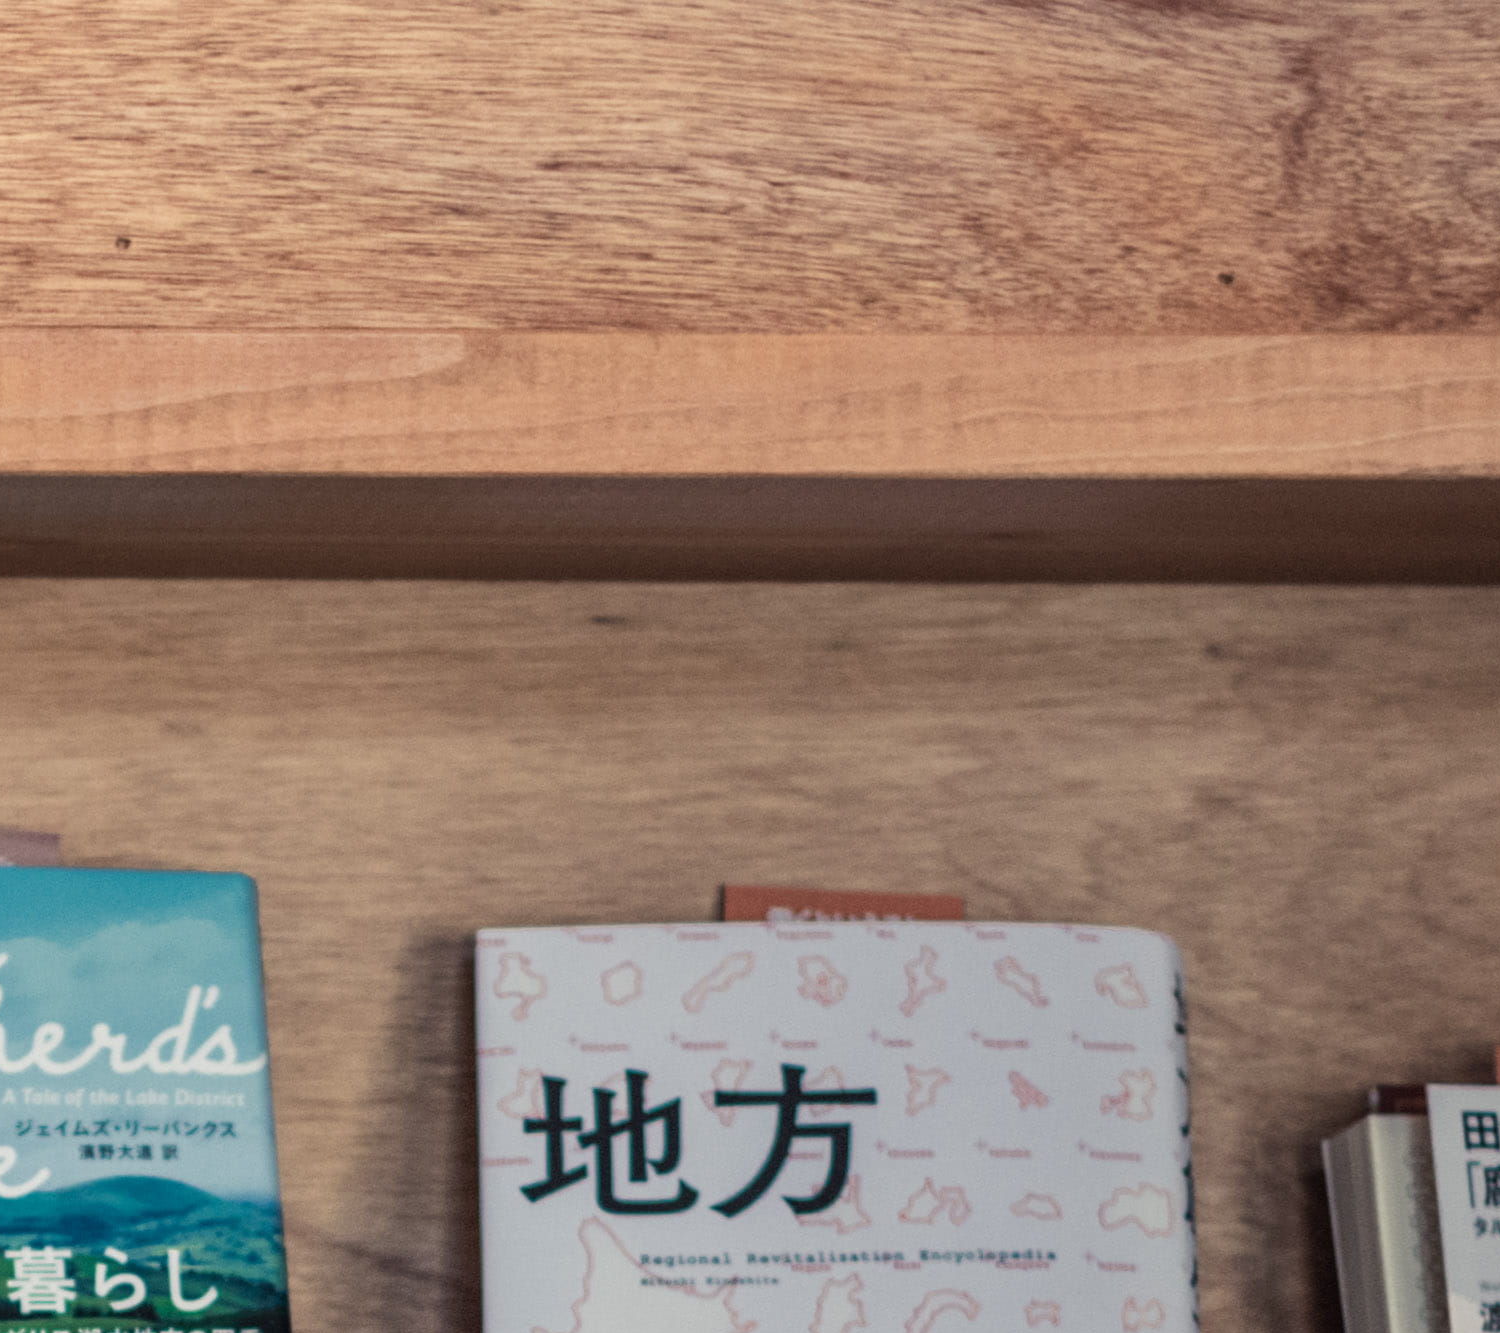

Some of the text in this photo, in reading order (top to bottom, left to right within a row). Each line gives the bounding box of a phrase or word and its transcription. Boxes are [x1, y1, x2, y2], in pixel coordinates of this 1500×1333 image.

[2, 1088, 246, 1109] A Tale of the Lake District
[14, 1119, 238, 1139] ジェイムズ・リーバンクス
[519, 1062, 878, 1218] 地方
[640, 1251, 732, 1268] Regional
[919, 1246, 1058, 1265] Encyclopedia
